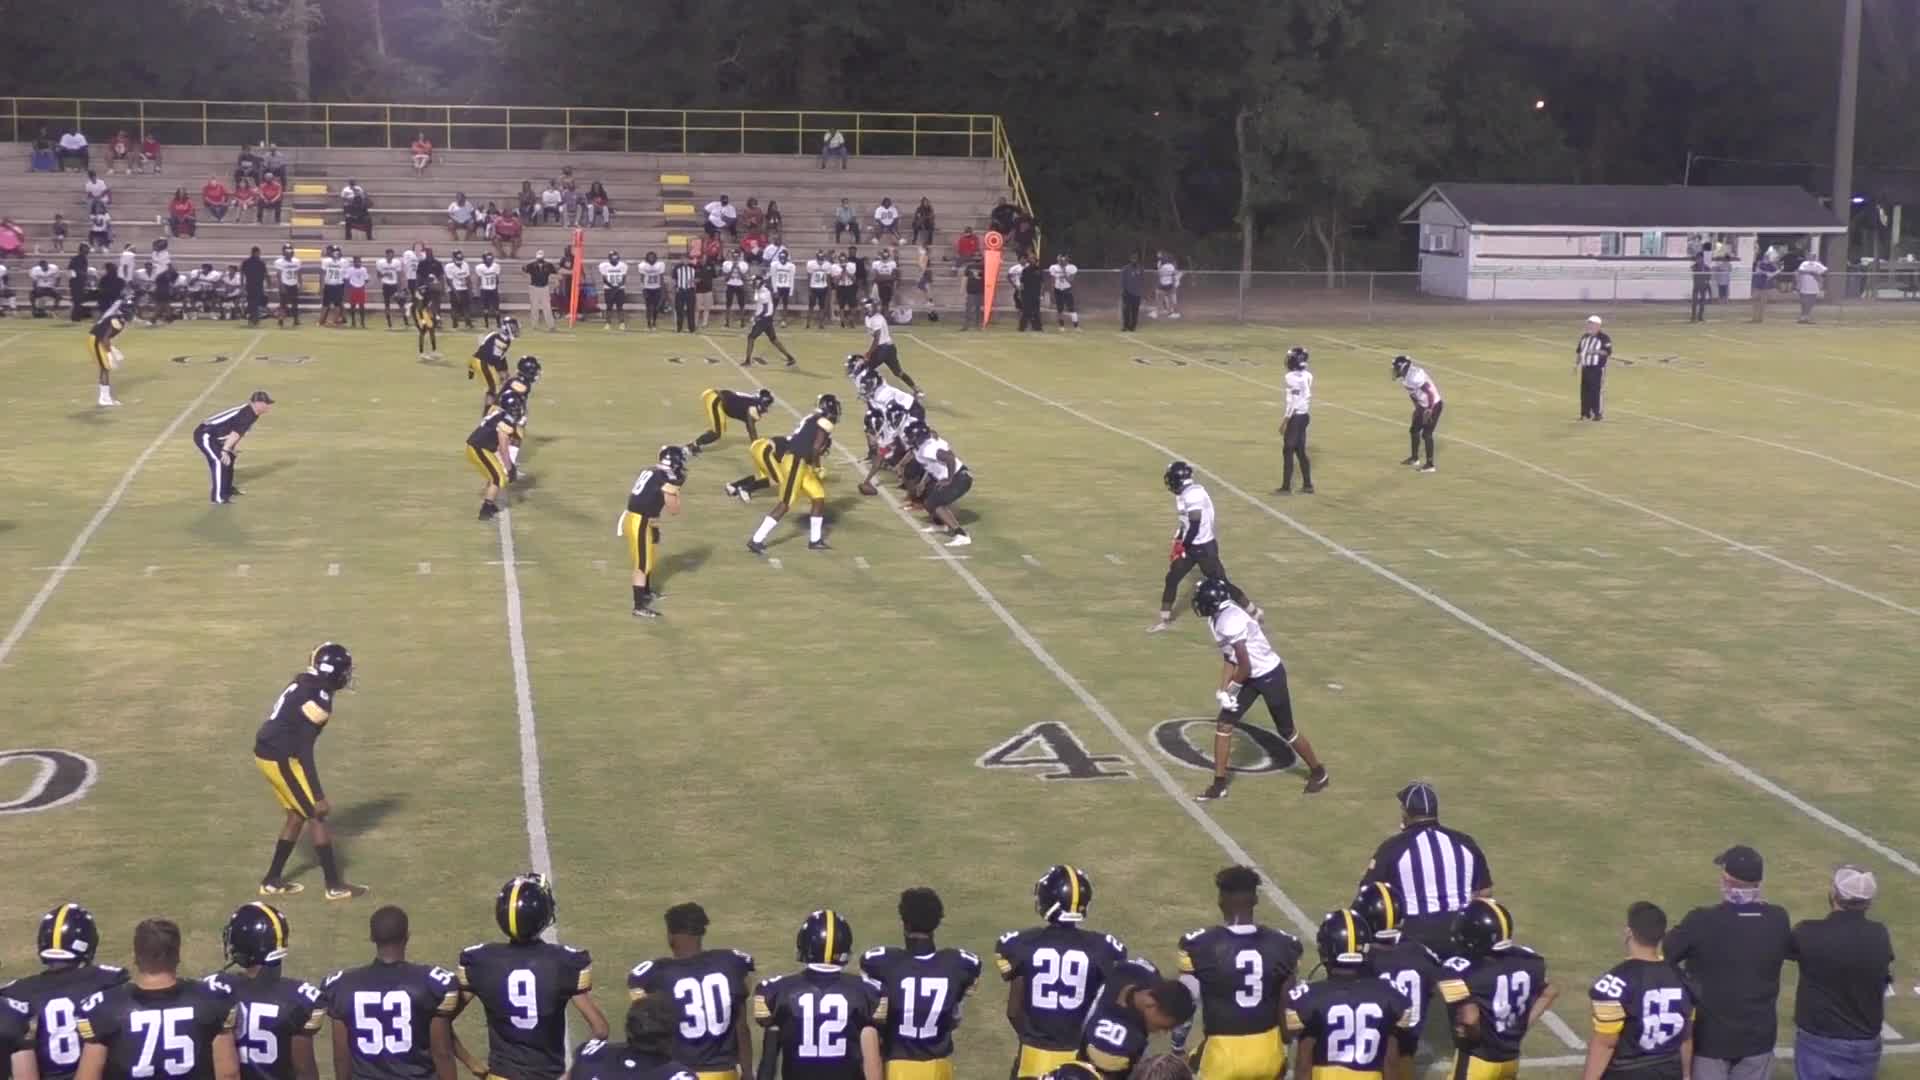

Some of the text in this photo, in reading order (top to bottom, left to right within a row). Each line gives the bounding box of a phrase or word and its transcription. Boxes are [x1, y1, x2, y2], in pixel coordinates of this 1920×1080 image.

[508, 969, 538, 1030] 9
[674, 973, 732, 1039] 30
[899, 977, 949, 1039] 17
[1032, 948, 1089, 1010] 29
[1236, 949, 1264, 1008] 3
[1492, 970, 1531, 1033] 43
[1592, 973, 1627, 998] 65
[44, 997, 81, 1065] 8
[130, 1007, 195, 1078] 75
[354, 990, 413, 1055] 53
[798, 993, 849, 1057] 12
[1094, 1019, 1128, 1046] 20
[1327, 1003, 1383, 1064] 26
[1639, 988, 1685, 1050] 65
